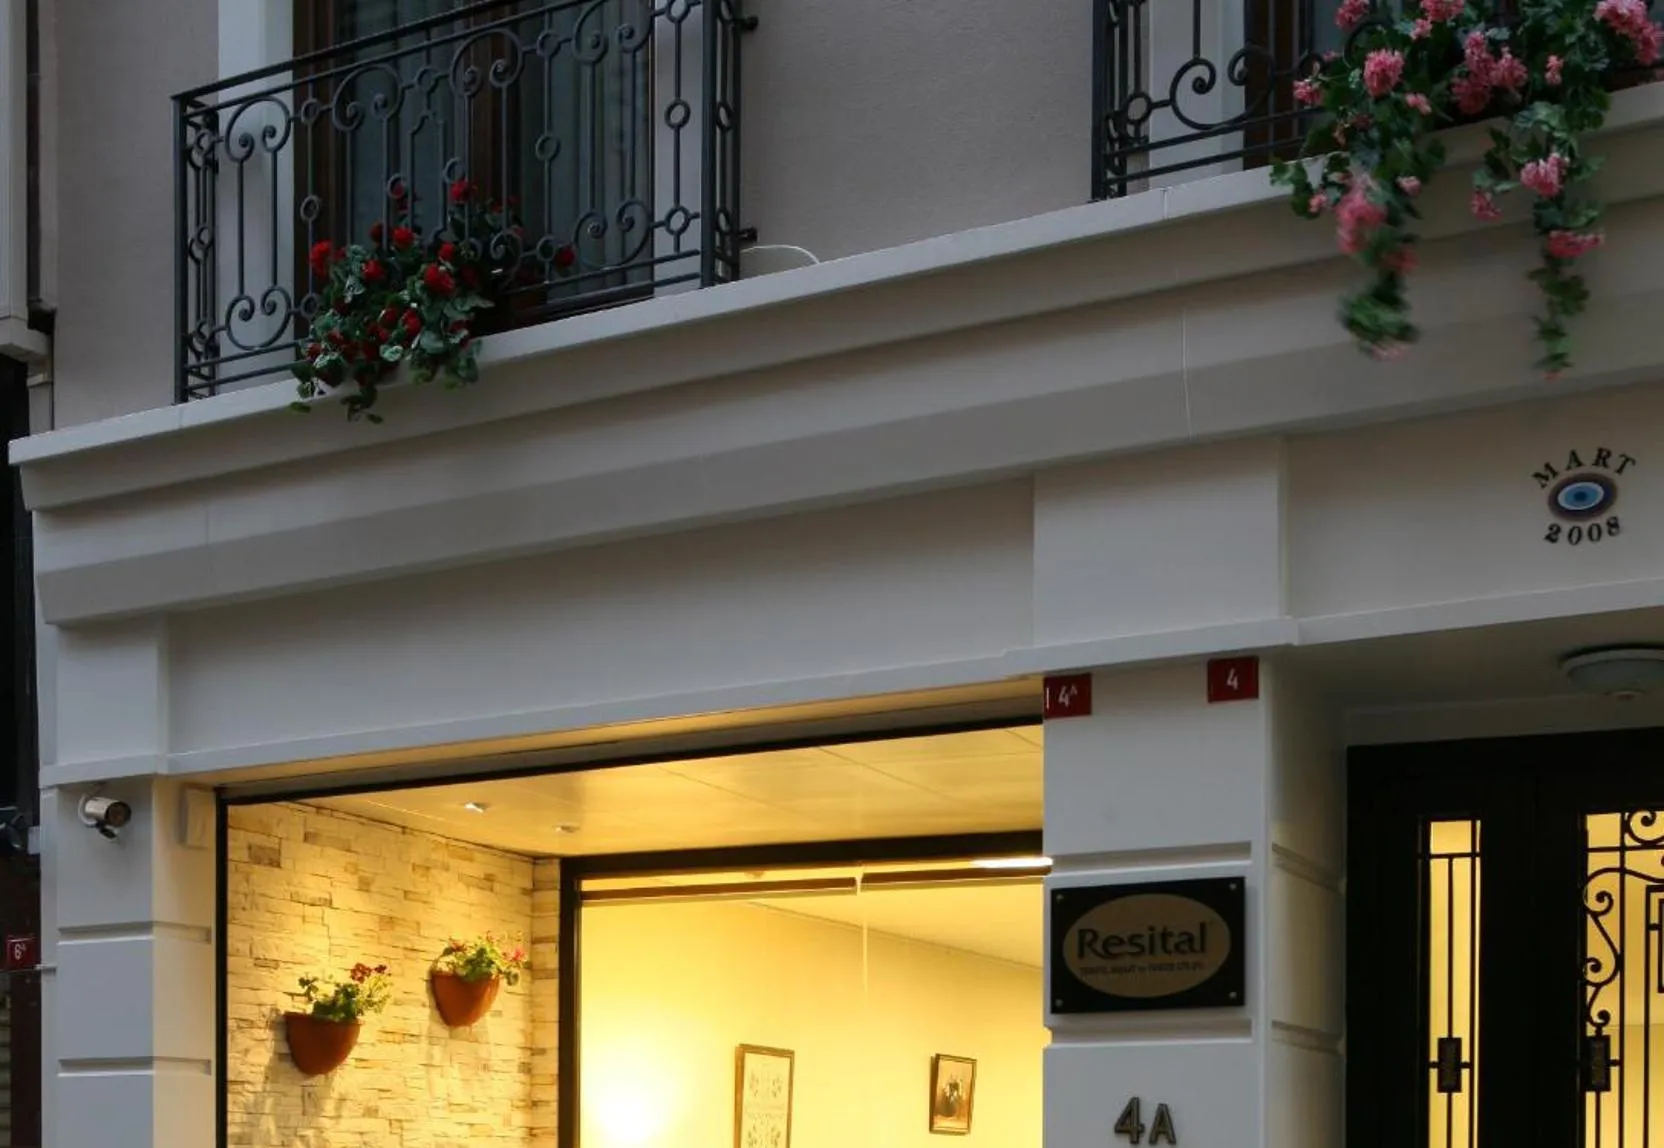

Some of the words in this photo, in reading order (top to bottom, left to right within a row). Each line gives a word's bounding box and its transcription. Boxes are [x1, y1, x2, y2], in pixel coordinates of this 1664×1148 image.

[1531, 447, 1636, 489] MART
[1543, 515, 1621, 546] 2008
[1226, 668, 1239, 689] 4
[1077, 921, 1207, 960] Resital
[1114, 1096, 1177, 1146] 4A
